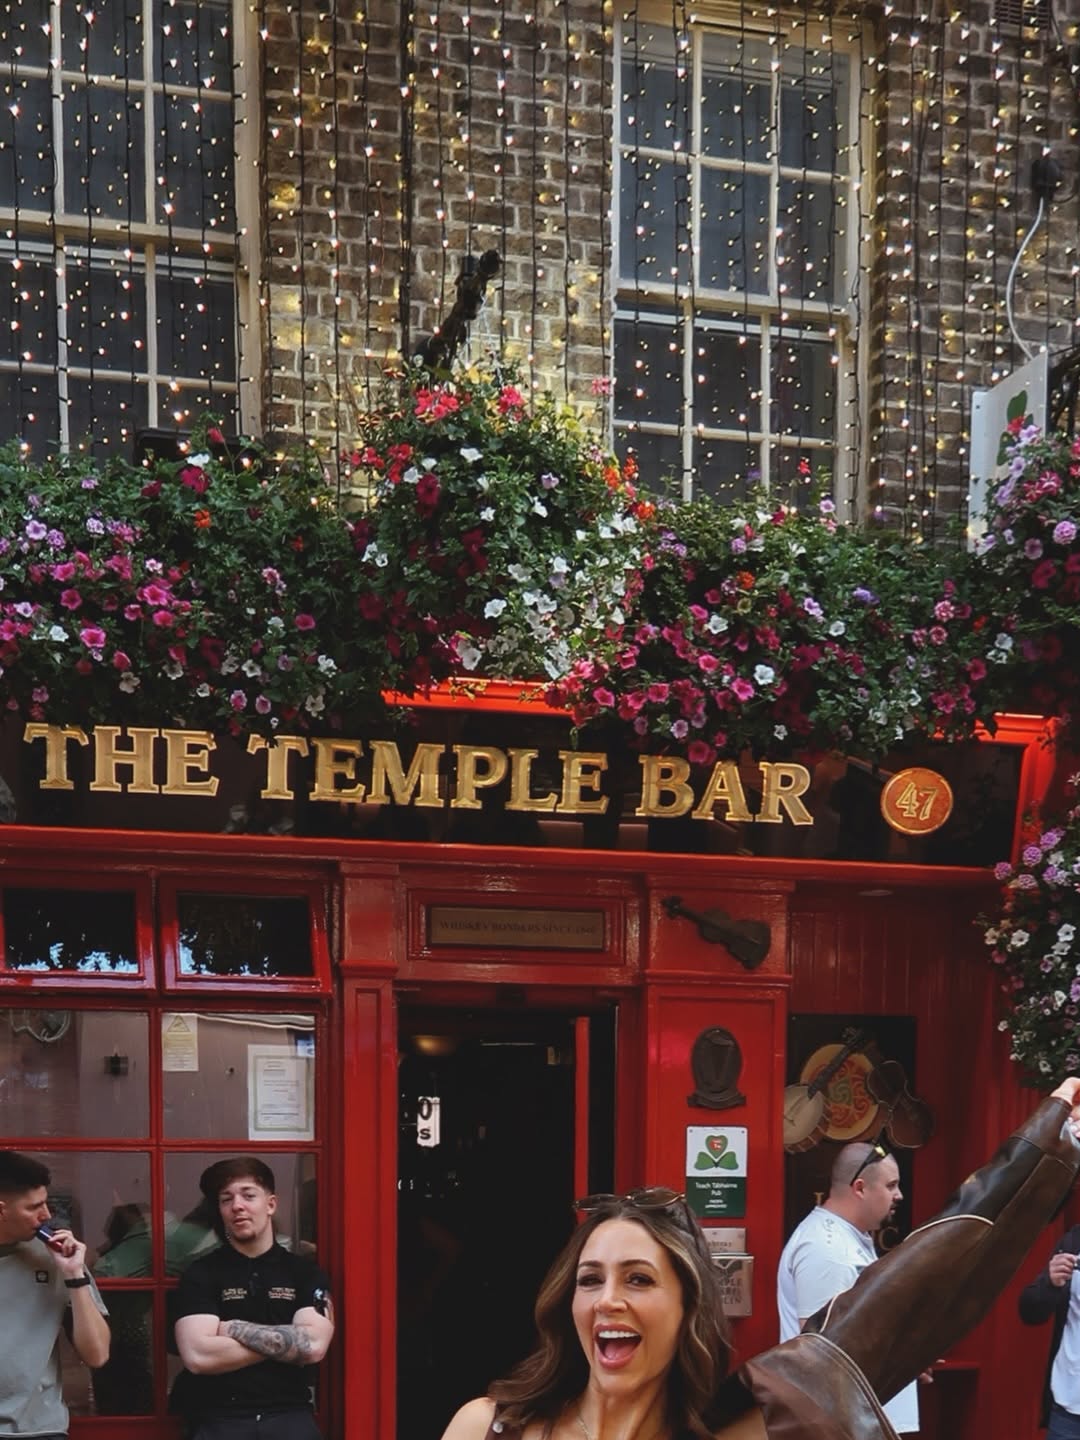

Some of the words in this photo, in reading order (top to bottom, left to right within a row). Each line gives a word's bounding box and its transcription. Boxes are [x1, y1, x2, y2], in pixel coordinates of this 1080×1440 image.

[23, 722, 220, 797] THE
[246, 733, 610, 817] TEMPLE
[635, 754, 814, 827] BAR
[895, 782, 938, 821] 47
